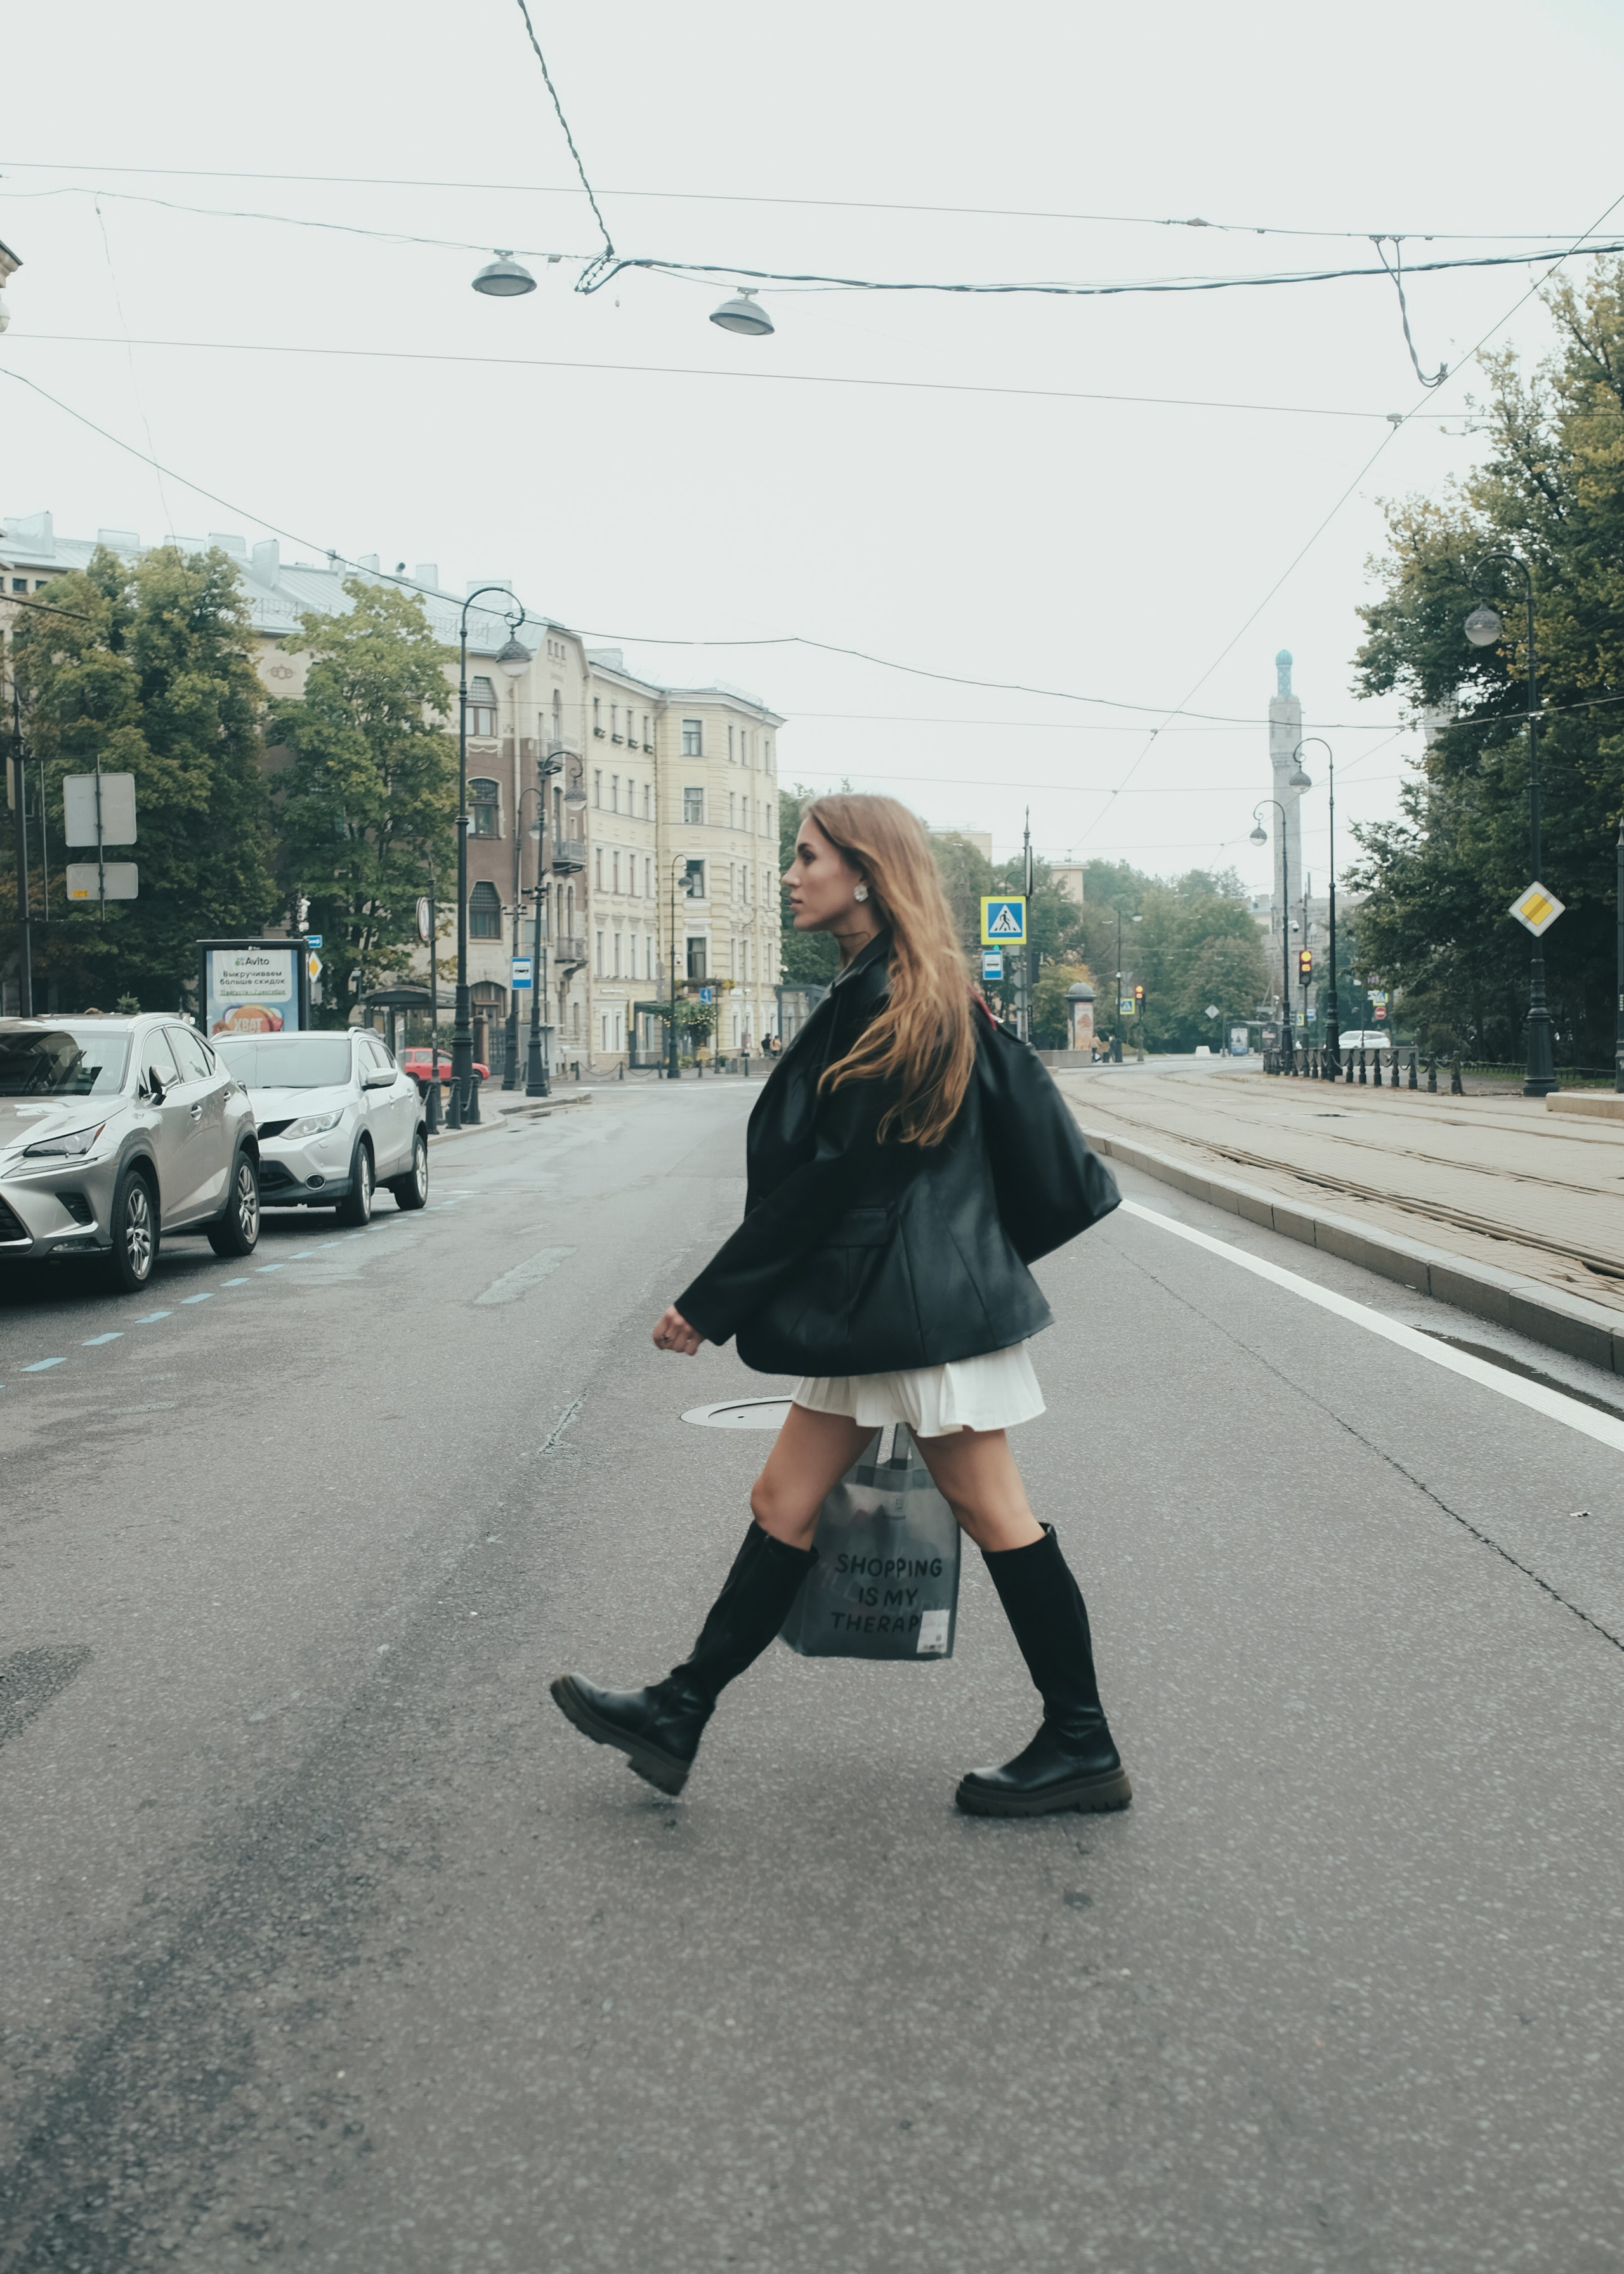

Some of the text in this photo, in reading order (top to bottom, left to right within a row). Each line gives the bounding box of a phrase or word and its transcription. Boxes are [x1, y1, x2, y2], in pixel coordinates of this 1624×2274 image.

[246, 957, 270, 965] Avito
[233, 1017, 263, 1031] ХВАТ
[835, 1553, 942, 1578] SHOPPING
[858, 1587, 879, 1607] IS
[884, 1588, 919, 1607] MY
[831, 1612, 923, 1633] THERAP
